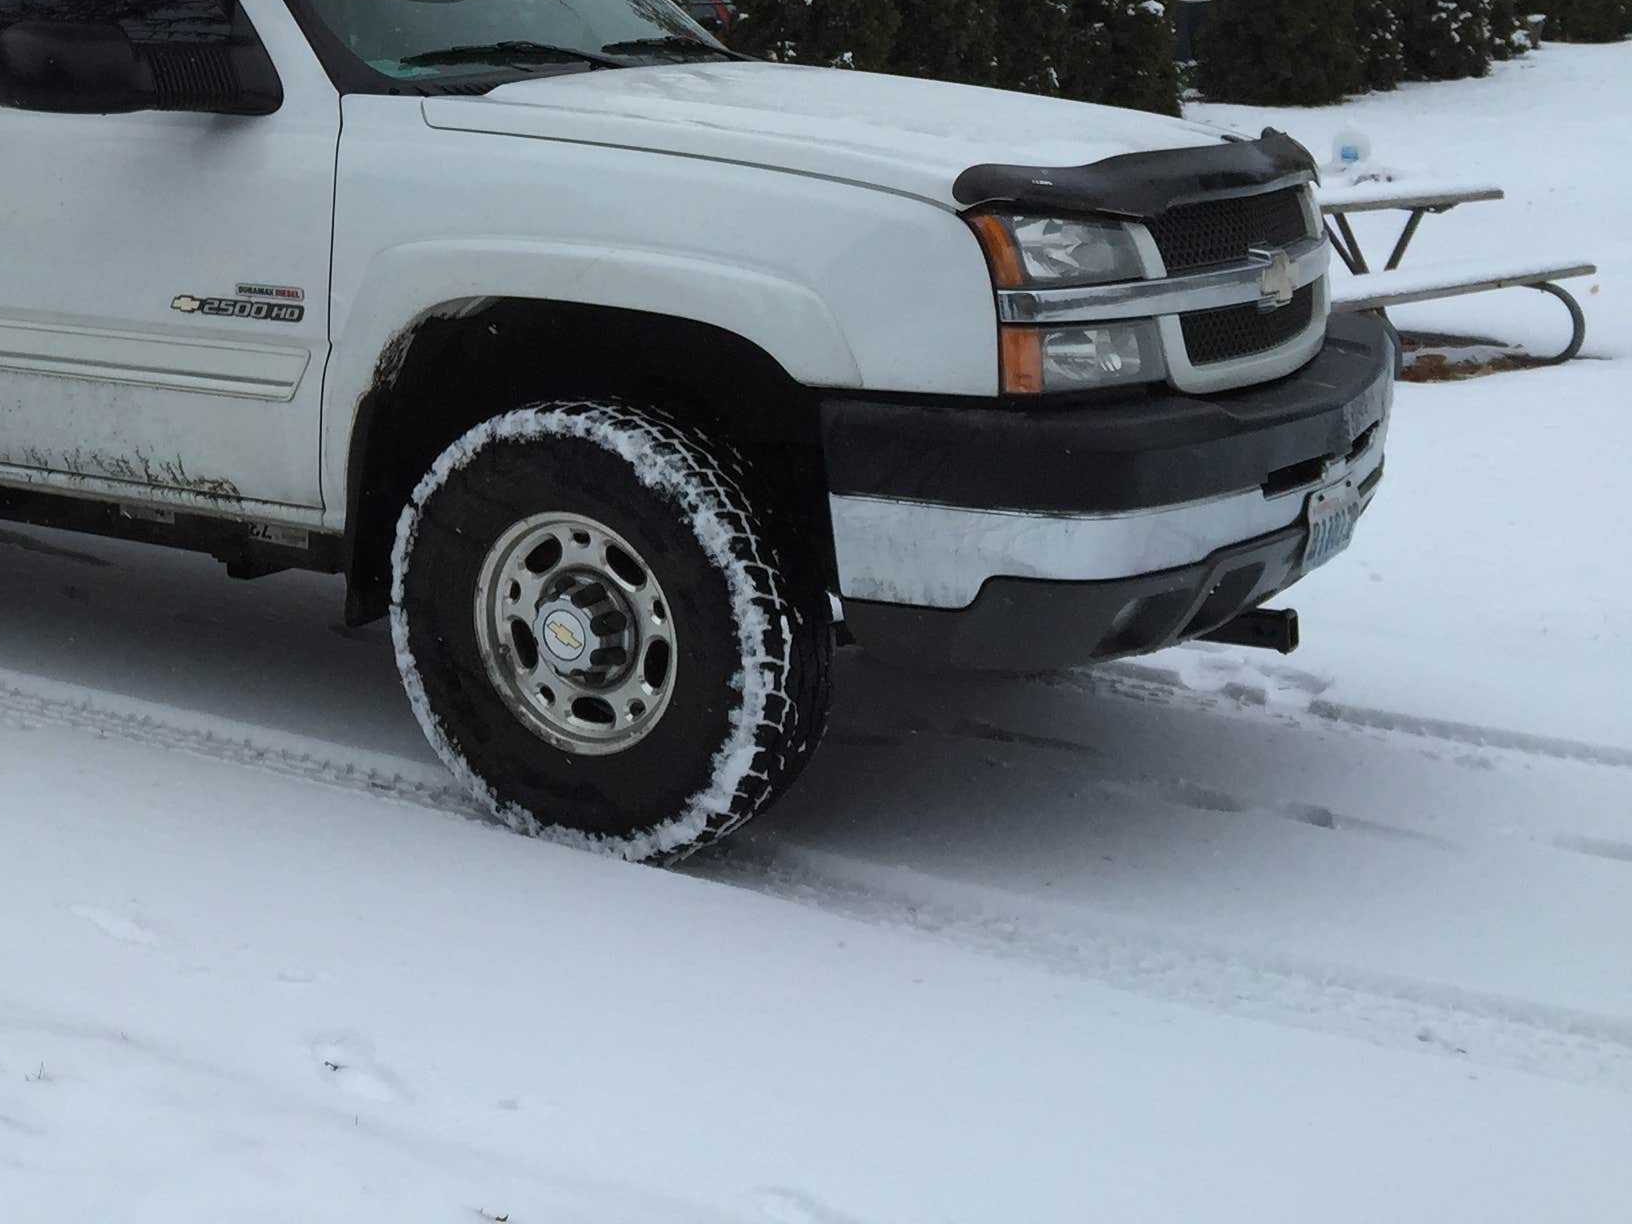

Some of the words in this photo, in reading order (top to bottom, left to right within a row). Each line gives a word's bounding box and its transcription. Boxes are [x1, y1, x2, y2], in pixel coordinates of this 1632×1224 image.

[238, 286, 274, 296] DURAMAX
[275, 289, 301, 298] DIESEL
[202, 299, 268, 319] 2500
